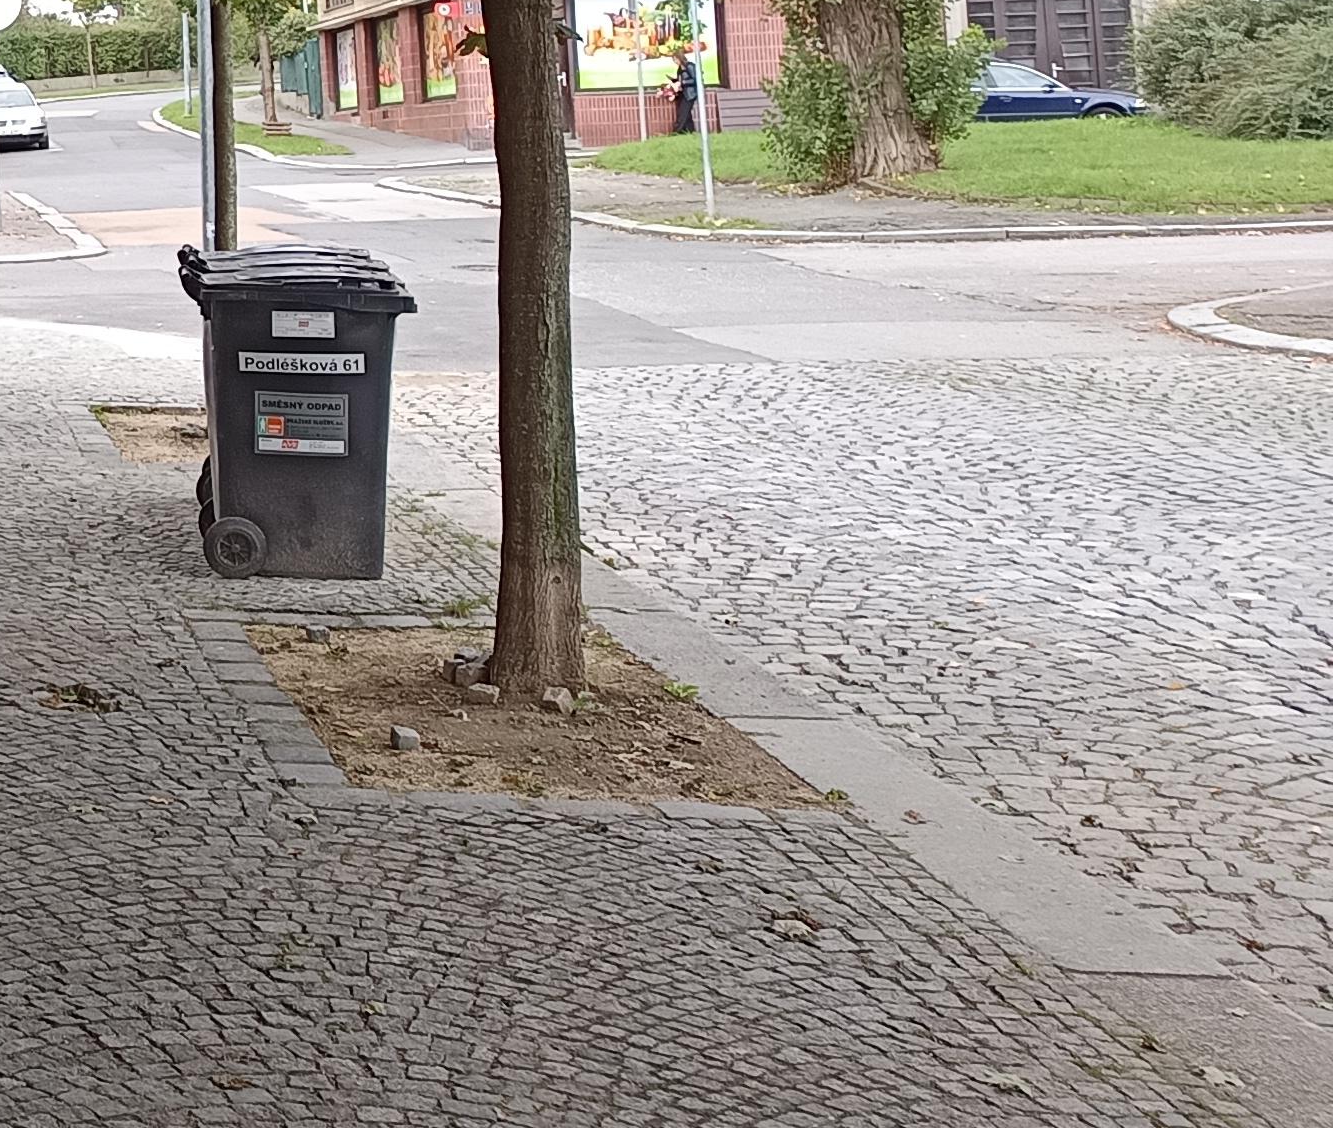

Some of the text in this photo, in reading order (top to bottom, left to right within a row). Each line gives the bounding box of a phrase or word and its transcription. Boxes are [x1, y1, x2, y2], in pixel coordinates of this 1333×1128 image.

[244, 356, 360, 372] Podléšková 61
[306, 402, 342, 411] ODPAD
